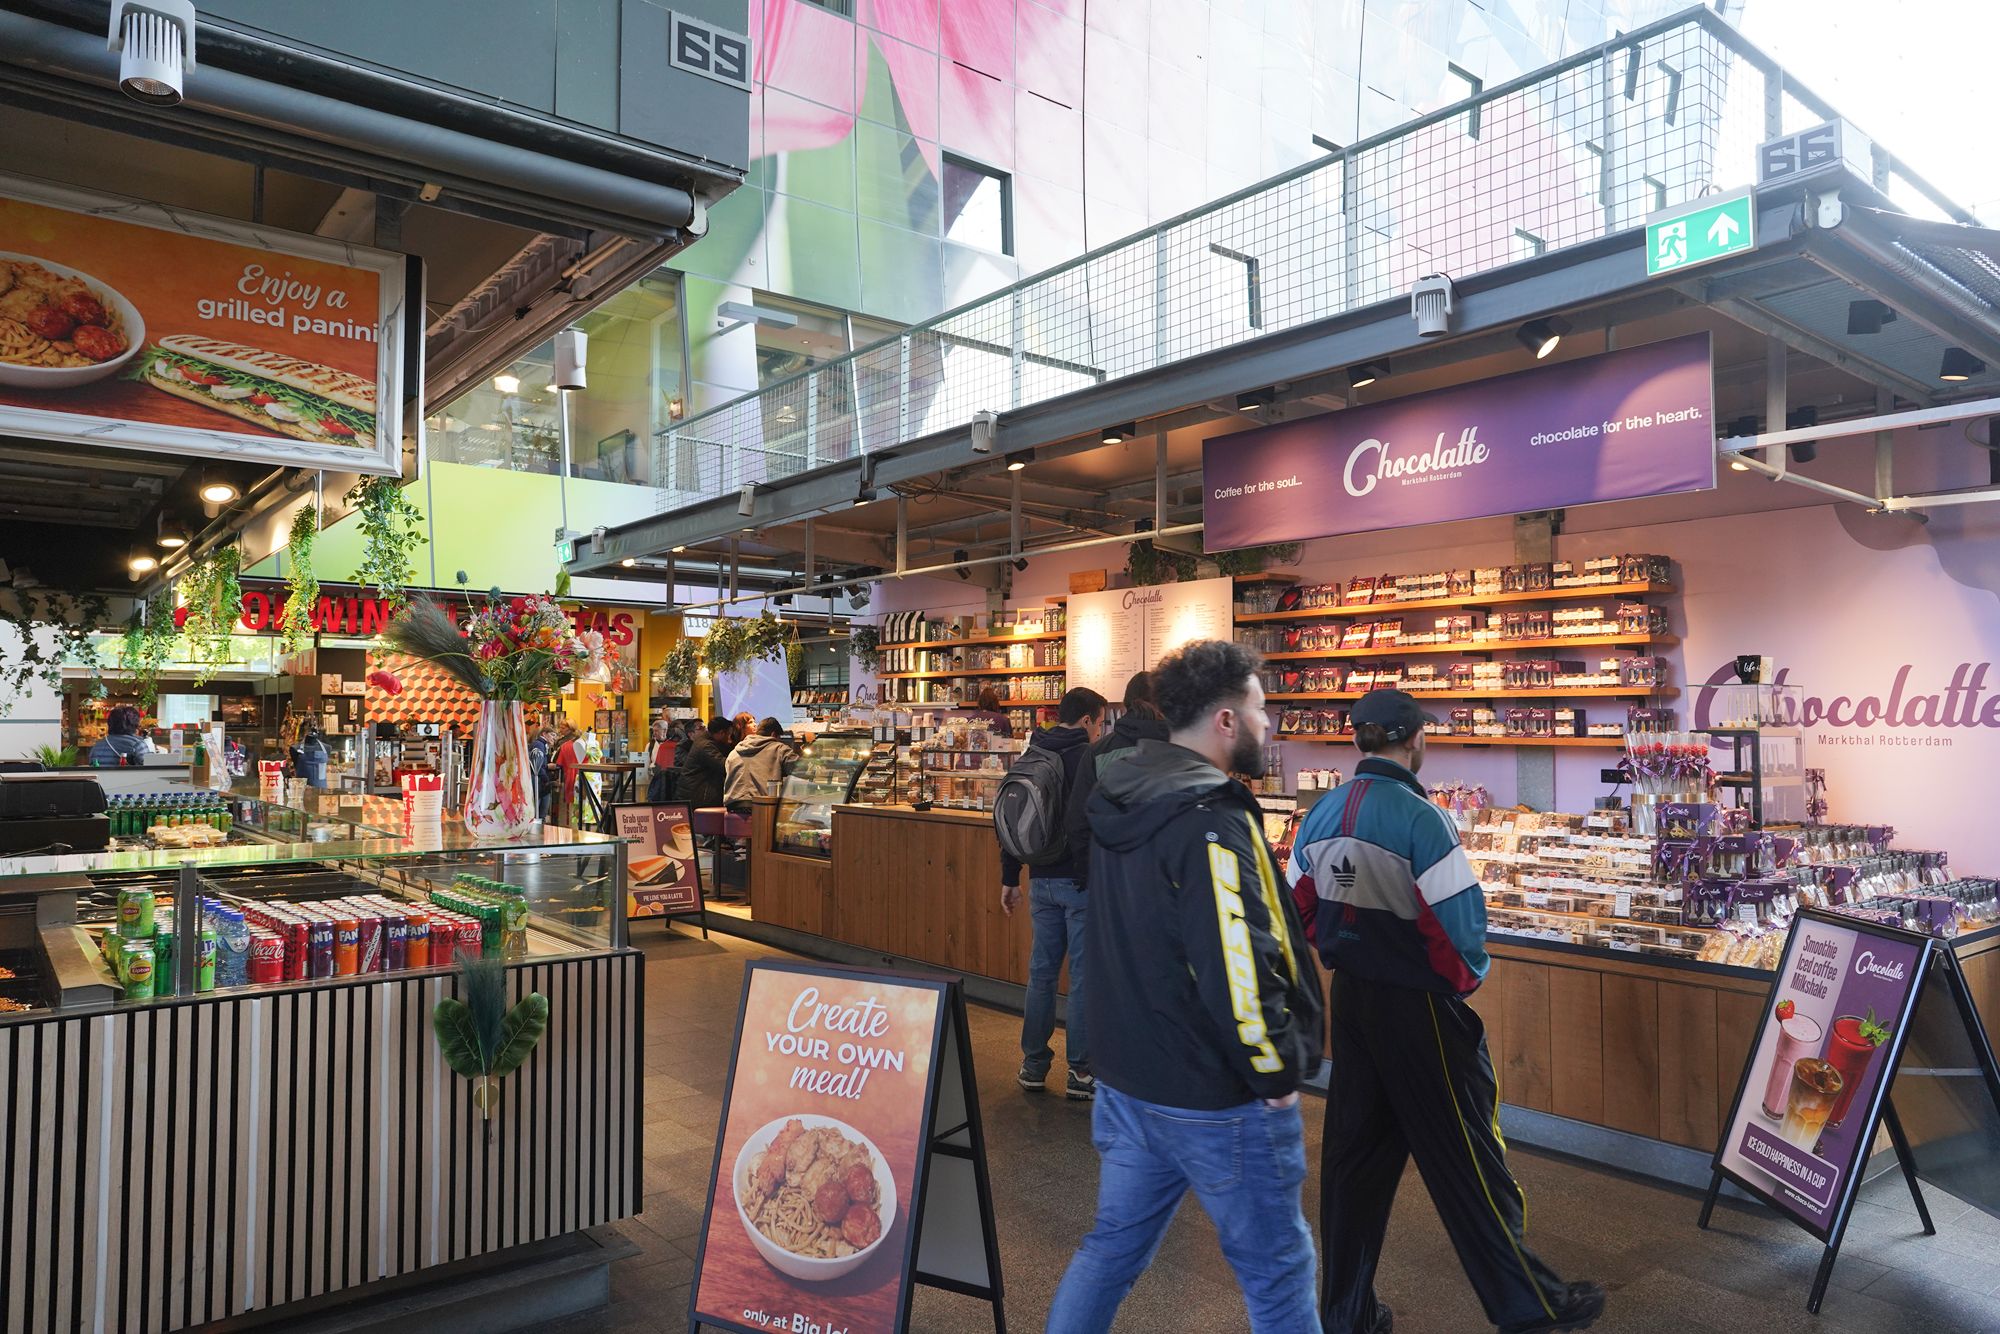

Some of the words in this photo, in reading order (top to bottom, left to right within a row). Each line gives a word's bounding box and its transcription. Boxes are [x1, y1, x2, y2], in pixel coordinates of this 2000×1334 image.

[678, 21, 746, 84] 69
[1762, 124, 1834, 181] 66
[236, 264, 322, 310] Enjoy
[326, 289, 350, 310] a
[196, 298, 285, 328] grilled
[293, 314, 379, 343] panini
[1530, 424, 1599, 446] chocolate
[1602, 420, 1623, 434] for
[1625, 415, 1653, 430] the
[1656, 406, 1703, 425] heart.
[1343, 425, 1491, 497] Chocolatte
[1214, 485, 1243, 500] Coffee
[1244, 482, 1257, 495] for
[1258, 480, 1275, 493] the
[1401, 475, 1428, 486] Markthal
[1429, 471, 1463, 482] Rotterdam
[1122, 589, 1163, 610] Chocolatte
[687, 617, 709, 629] 118
[1818, 734, 1875, 746] Markthal
[1879, 734, 1953, 747] Rotterdam
[622, 814, 636, 824] Grab
[636, 815, 650, 825] your
[623, 823, 648, 834] favorite
[338, 928, 359, 942] FAN
[388, 924, 408, 938] FAN
[407, 923, 430, 936] FANT
[1802, 935, 1838, 960] Smoothie
[131, 966, 150, 974] Lipton
[1796, 954, 1813, 974] Iced
[1812, 959, 1838, 981] coffee
[1855, 951, 1904, 980] Chocolatte
[1790, 972, 1828, 1000] Milkshake
[787, 987, 890, 1038] Create
[766, 1031, 829, 1061] YOUR
[837, 1043, 904, 1072] OWN
[789, 1066, 871, 1100] meal!
[1746, 1135, 1758, 1151] ICE
[1755, 1140, 1771, 1158] COLD
[1769, 1148, 1802, 1176] HAPPINESS
[1799, 1166, 1809, 1181] IN
[1806, 1170, 1813, 1183] A
[1811, 1173, 1827, 1190] CUP
[743, 1308, 770, 1326] only
[773, 1316, 788, 1330] at
[791, 1312, 820, 1334] Big
